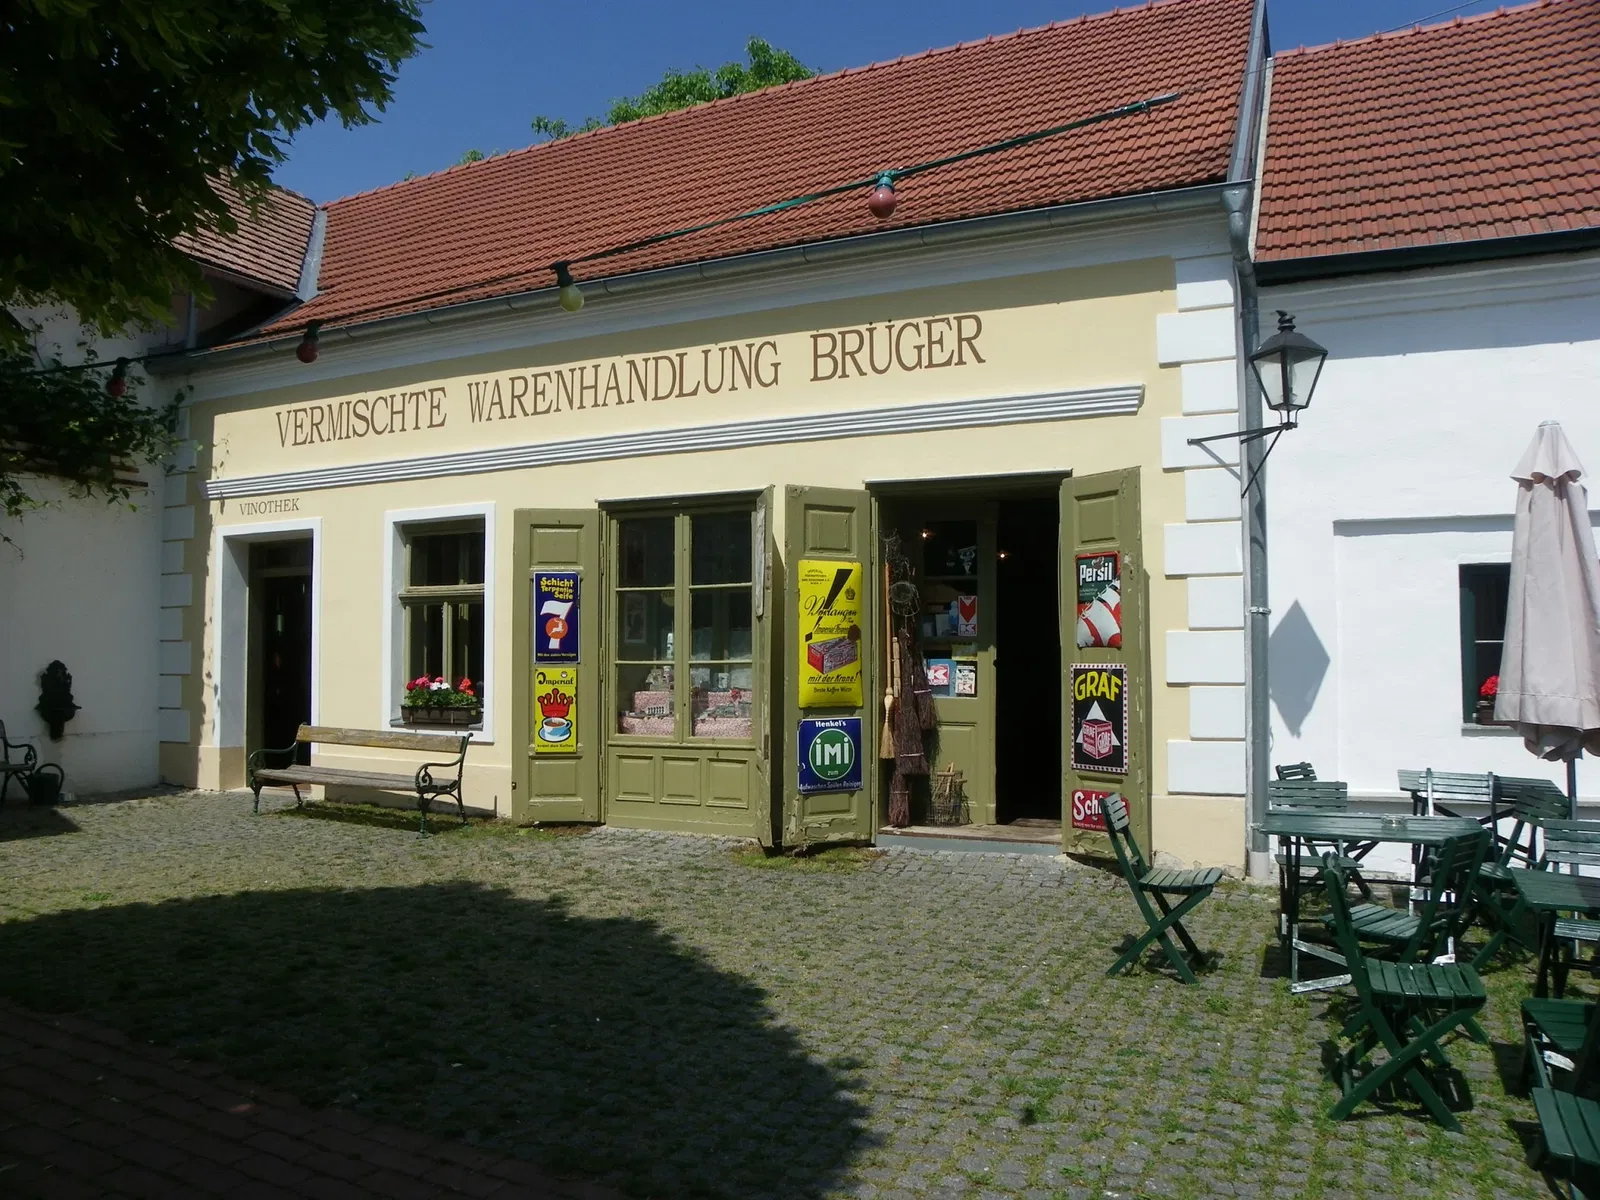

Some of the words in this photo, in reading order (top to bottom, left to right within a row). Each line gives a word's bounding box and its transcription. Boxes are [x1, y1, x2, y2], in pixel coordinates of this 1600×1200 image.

[275, 387, 447, 448] VERMISCHTE
[467, 340, 782, 423] WARENHANDLUNG
[810, 314, 986, 382] BRÜGER
[239, 497, 300, 516] VINOTHEK
[540, 577, 574, 588] Schicht
[1080, 562, 1113, 586] Persil
[554, 591, 574, 600] Seife
[804, 595, 857, 622] Verlangen
[537, 671, 574, 686] Imperial
[808, 674, 821, 682] mit
[822, 674, 834, 682] der
[835, 672, 858, 682] Krone!
[1074, 671, 1122, 701] GRAF
[815, 720, 847, 728] Henkel's
